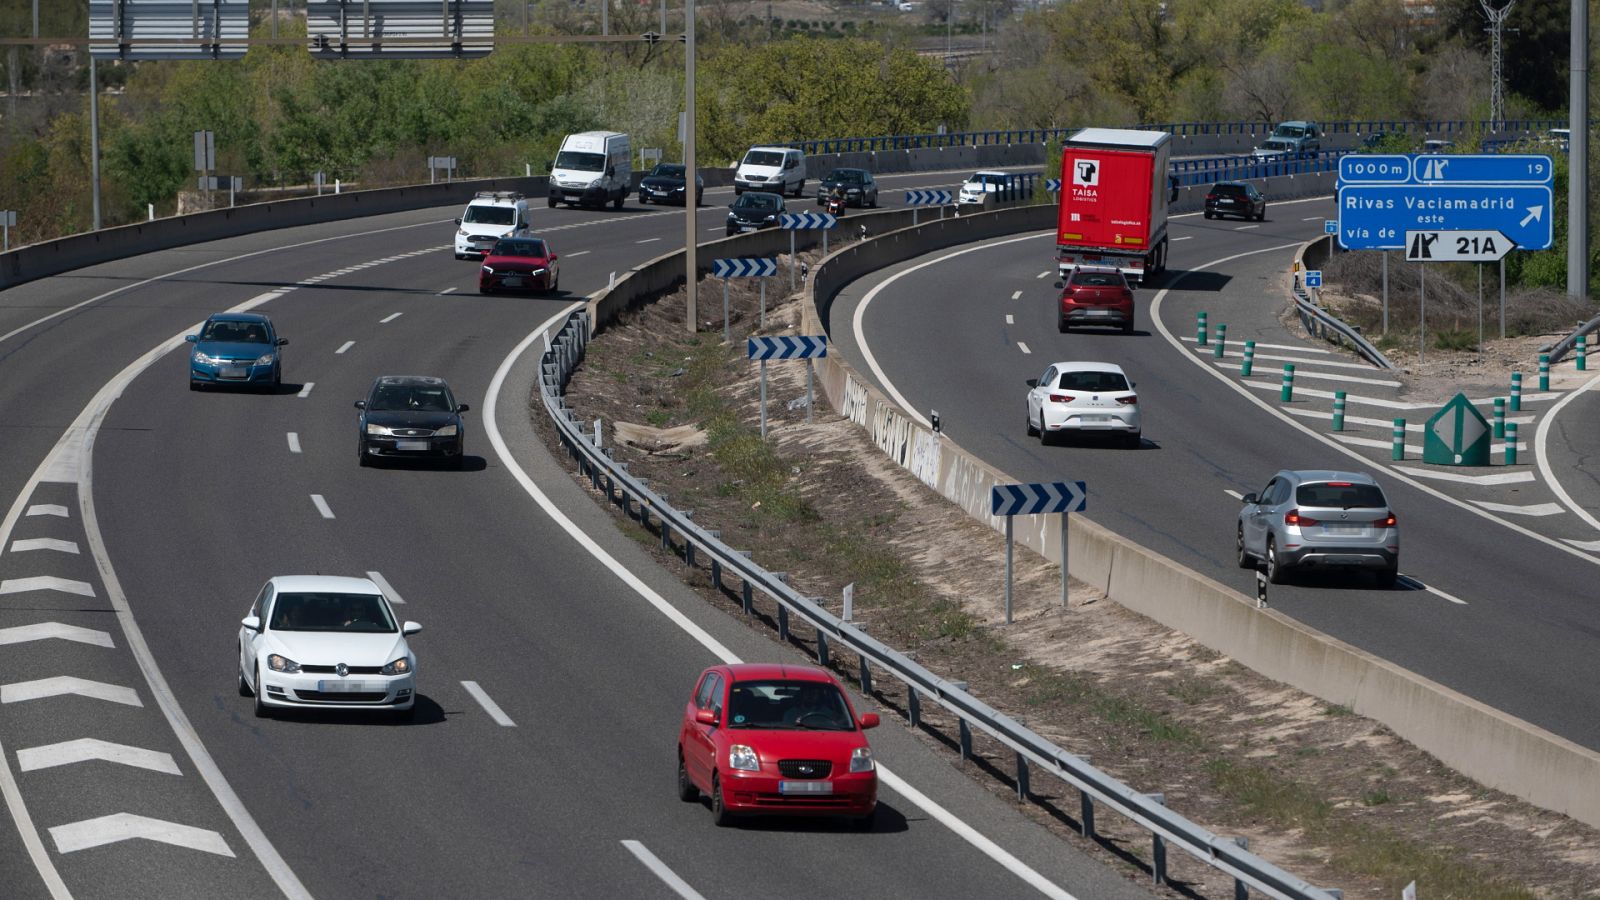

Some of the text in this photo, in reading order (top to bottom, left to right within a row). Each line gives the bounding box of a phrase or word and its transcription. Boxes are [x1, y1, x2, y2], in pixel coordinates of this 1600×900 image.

[1527, 163, 1544, 175] 19
[1072, 188, 1098, 197] TAISA
[1346, 196, 1515, 210] Rivas Vaciamadrid
[1417, 214, 1445, 224] este
[1347, 227, 1396, 239] vía de
[1456, 236, 1497, 255] 21A
